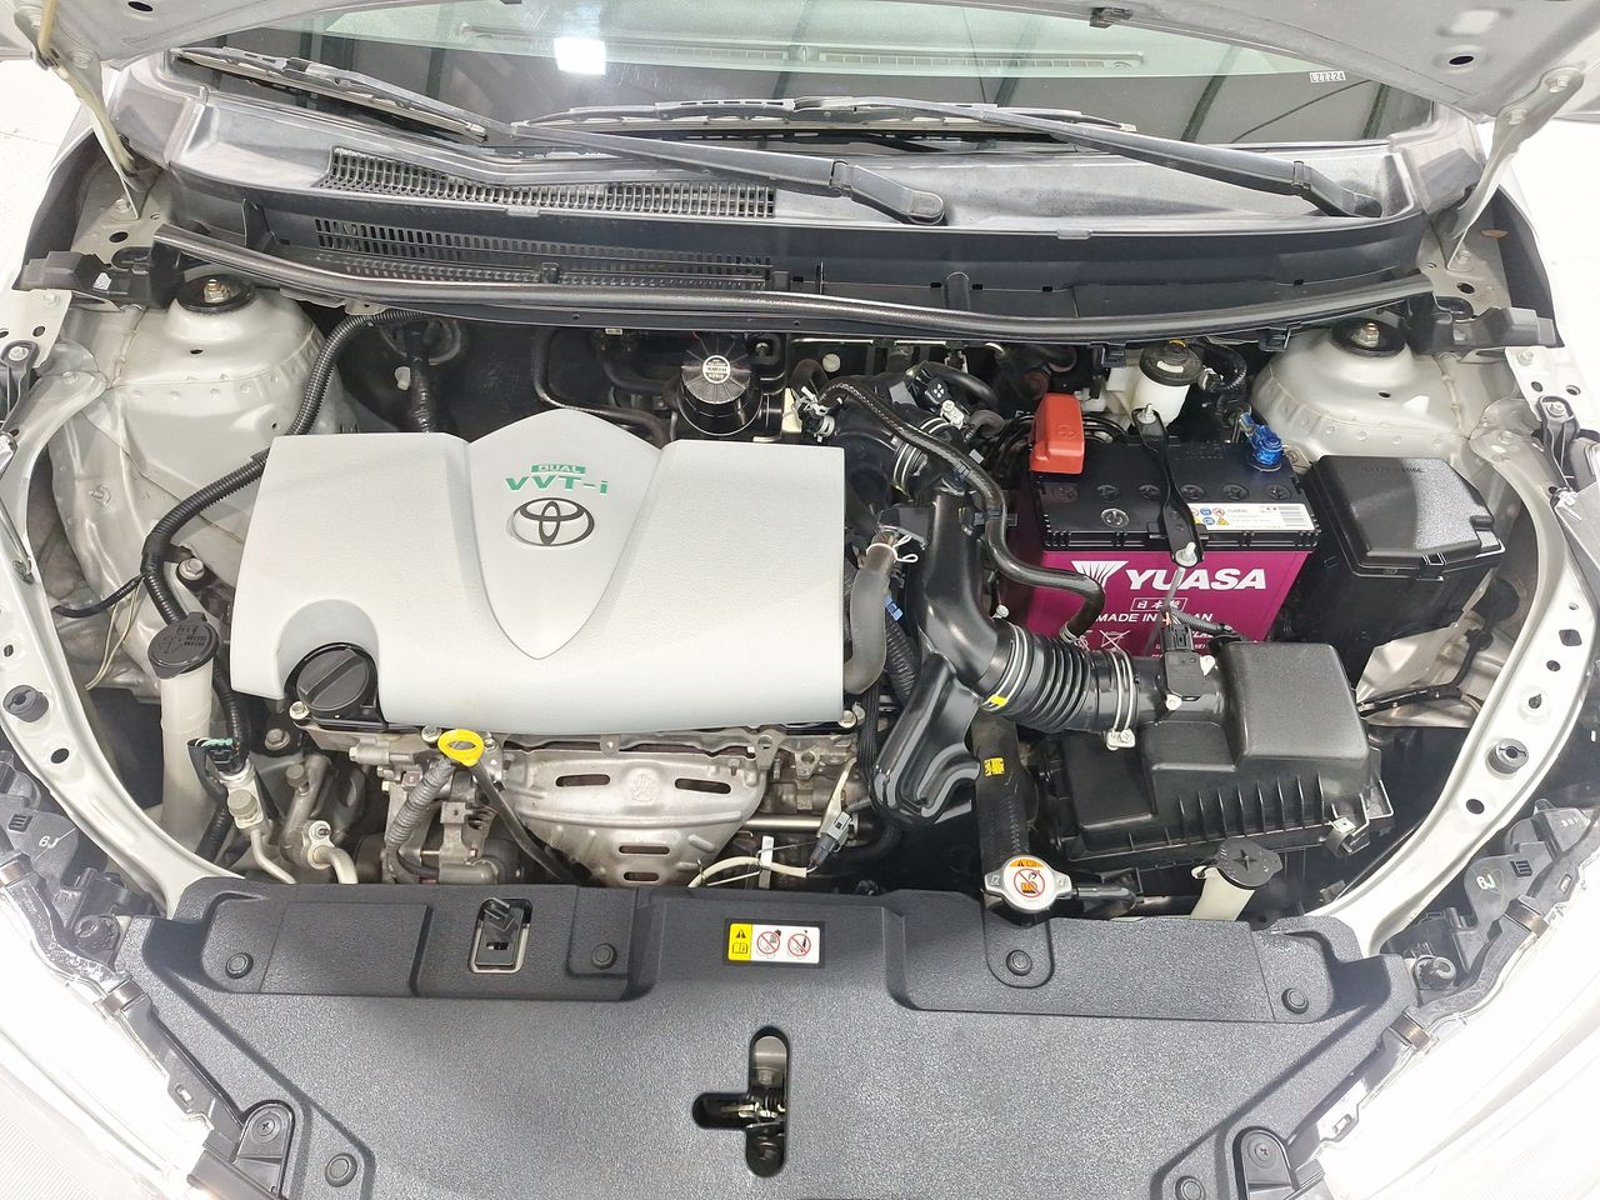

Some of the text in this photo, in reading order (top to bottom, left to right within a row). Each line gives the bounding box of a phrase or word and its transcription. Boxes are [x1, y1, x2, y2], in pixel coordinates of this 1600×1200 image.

[538, 464, 582, 474] DUAL
[505, 475, 608, 495] VVT-i
[1125, 568, 1266, 590] YUASA
[1096, 613, 1138, 622] MADE
[1142, 613, 1157, 622] IN
